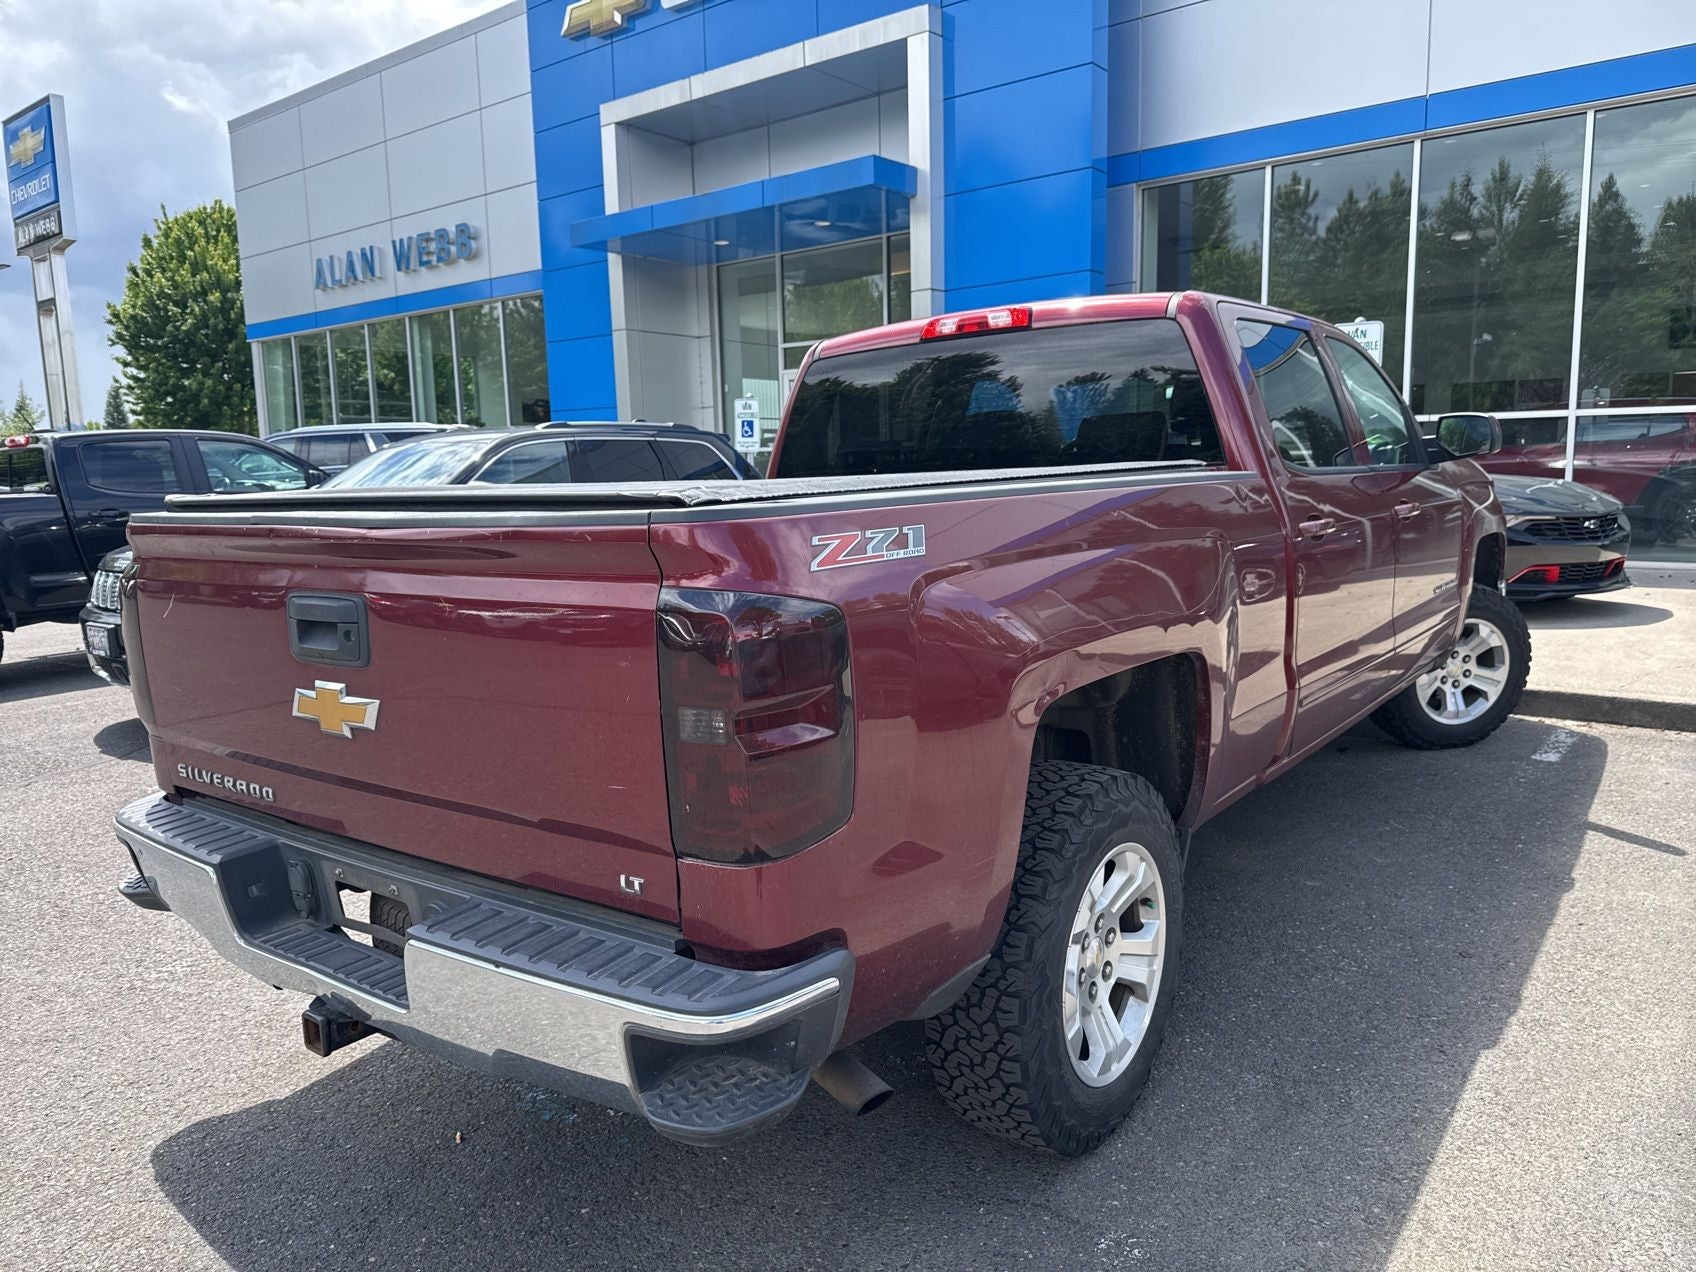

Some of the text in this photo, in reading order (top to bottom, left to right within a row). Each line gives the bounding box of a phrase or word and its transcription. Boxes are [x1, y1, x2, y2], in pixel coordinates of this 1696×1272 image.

[11, 174, 51, 205] CHEVROLET
[17, 216, 56, 246] ALAN WEBB
[314, 222, 479, 290] ALAN WEBB
[810, 524, 926, 573] Z71
[885, 547, 925, 560] OFF ROAD
[177, 762, 274, 803] SILVERADO
[619, 874, 645, 895] LT
